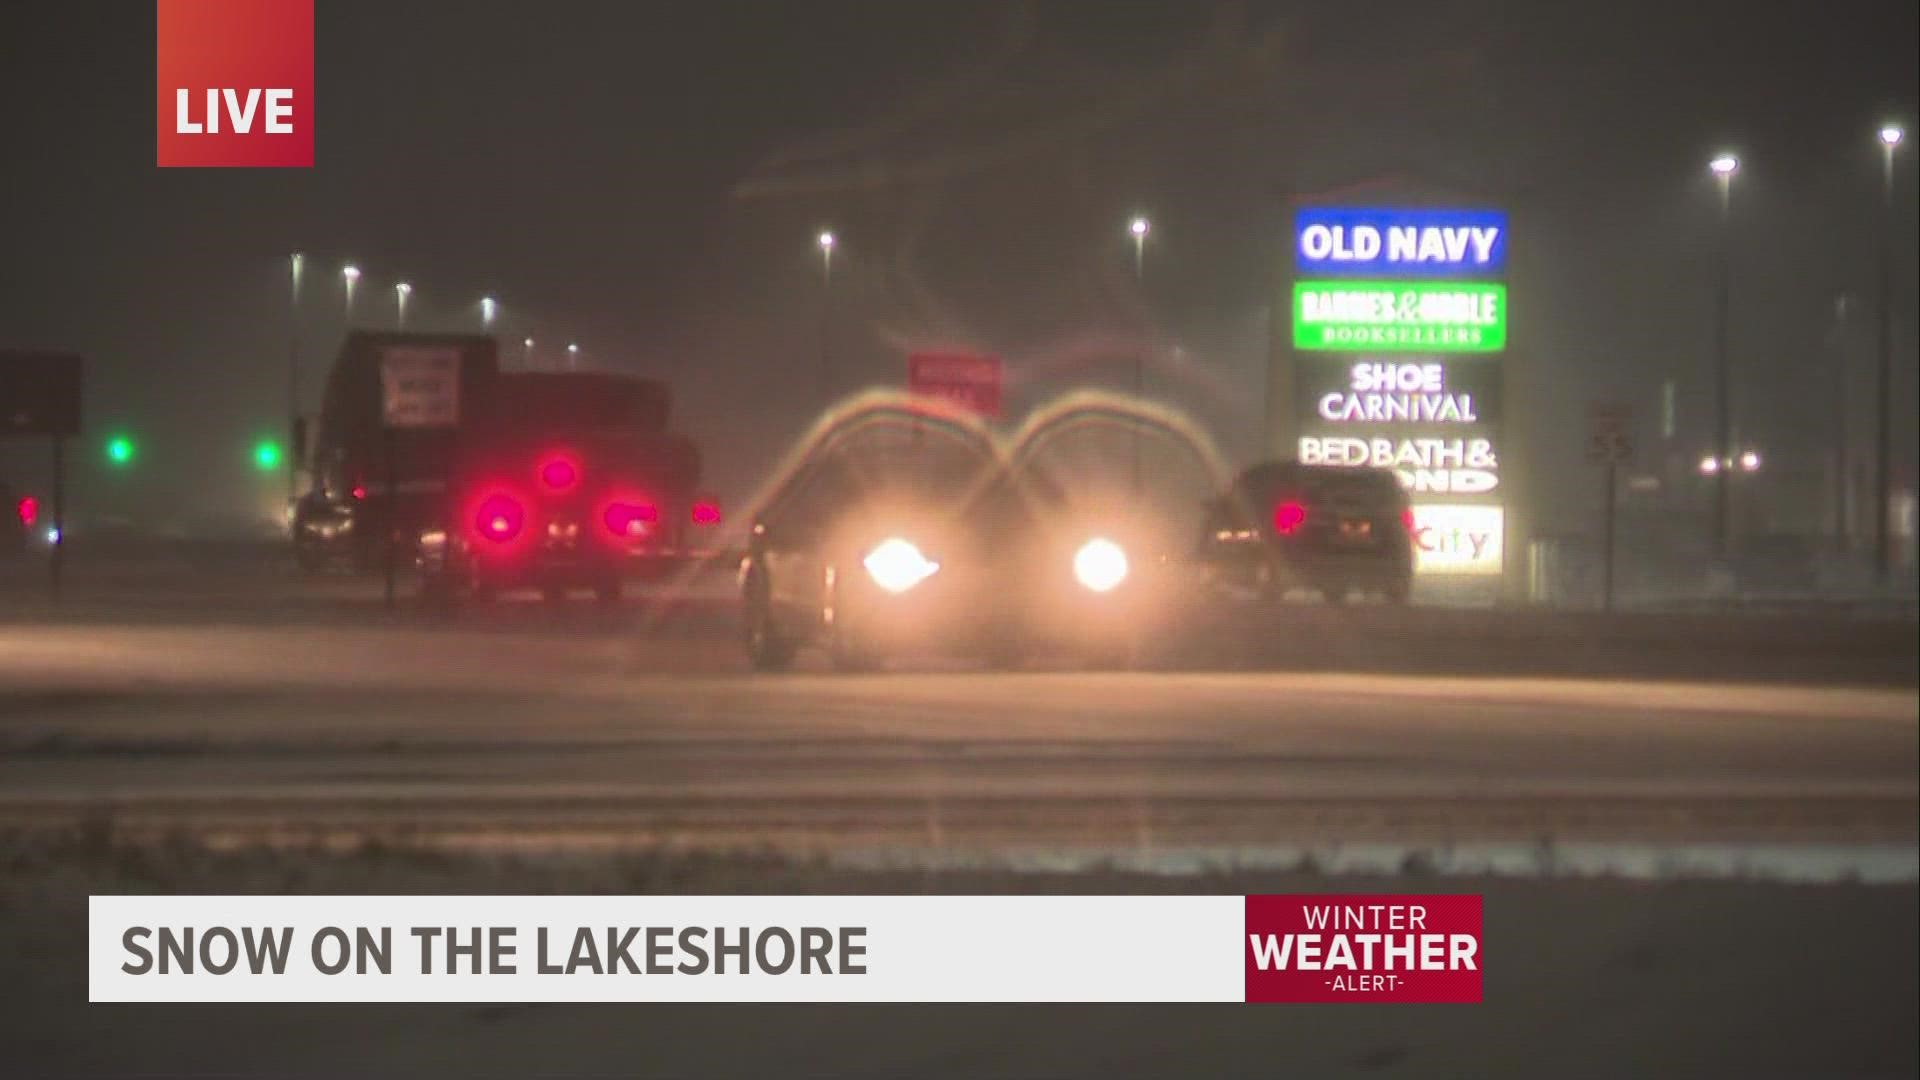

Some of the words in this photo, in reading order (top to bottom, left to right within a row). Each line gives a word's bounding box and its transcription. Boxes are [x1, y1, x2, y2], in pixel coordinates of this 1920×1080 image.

[1302, 225, 1381, 261] OLD
[1388, 228, 1498, 263] NAVY
[1322, 326, 1483, 345] BOOKSELLERS
[1351, 363, 1442, 391] SHOE
[1319, 392, 1476, 422] CARNIVAL
[1299, 437, 1369, 466] BED
[1370, 438, 1463, 467] BATH
[1466, 438, 1498, 468] &
